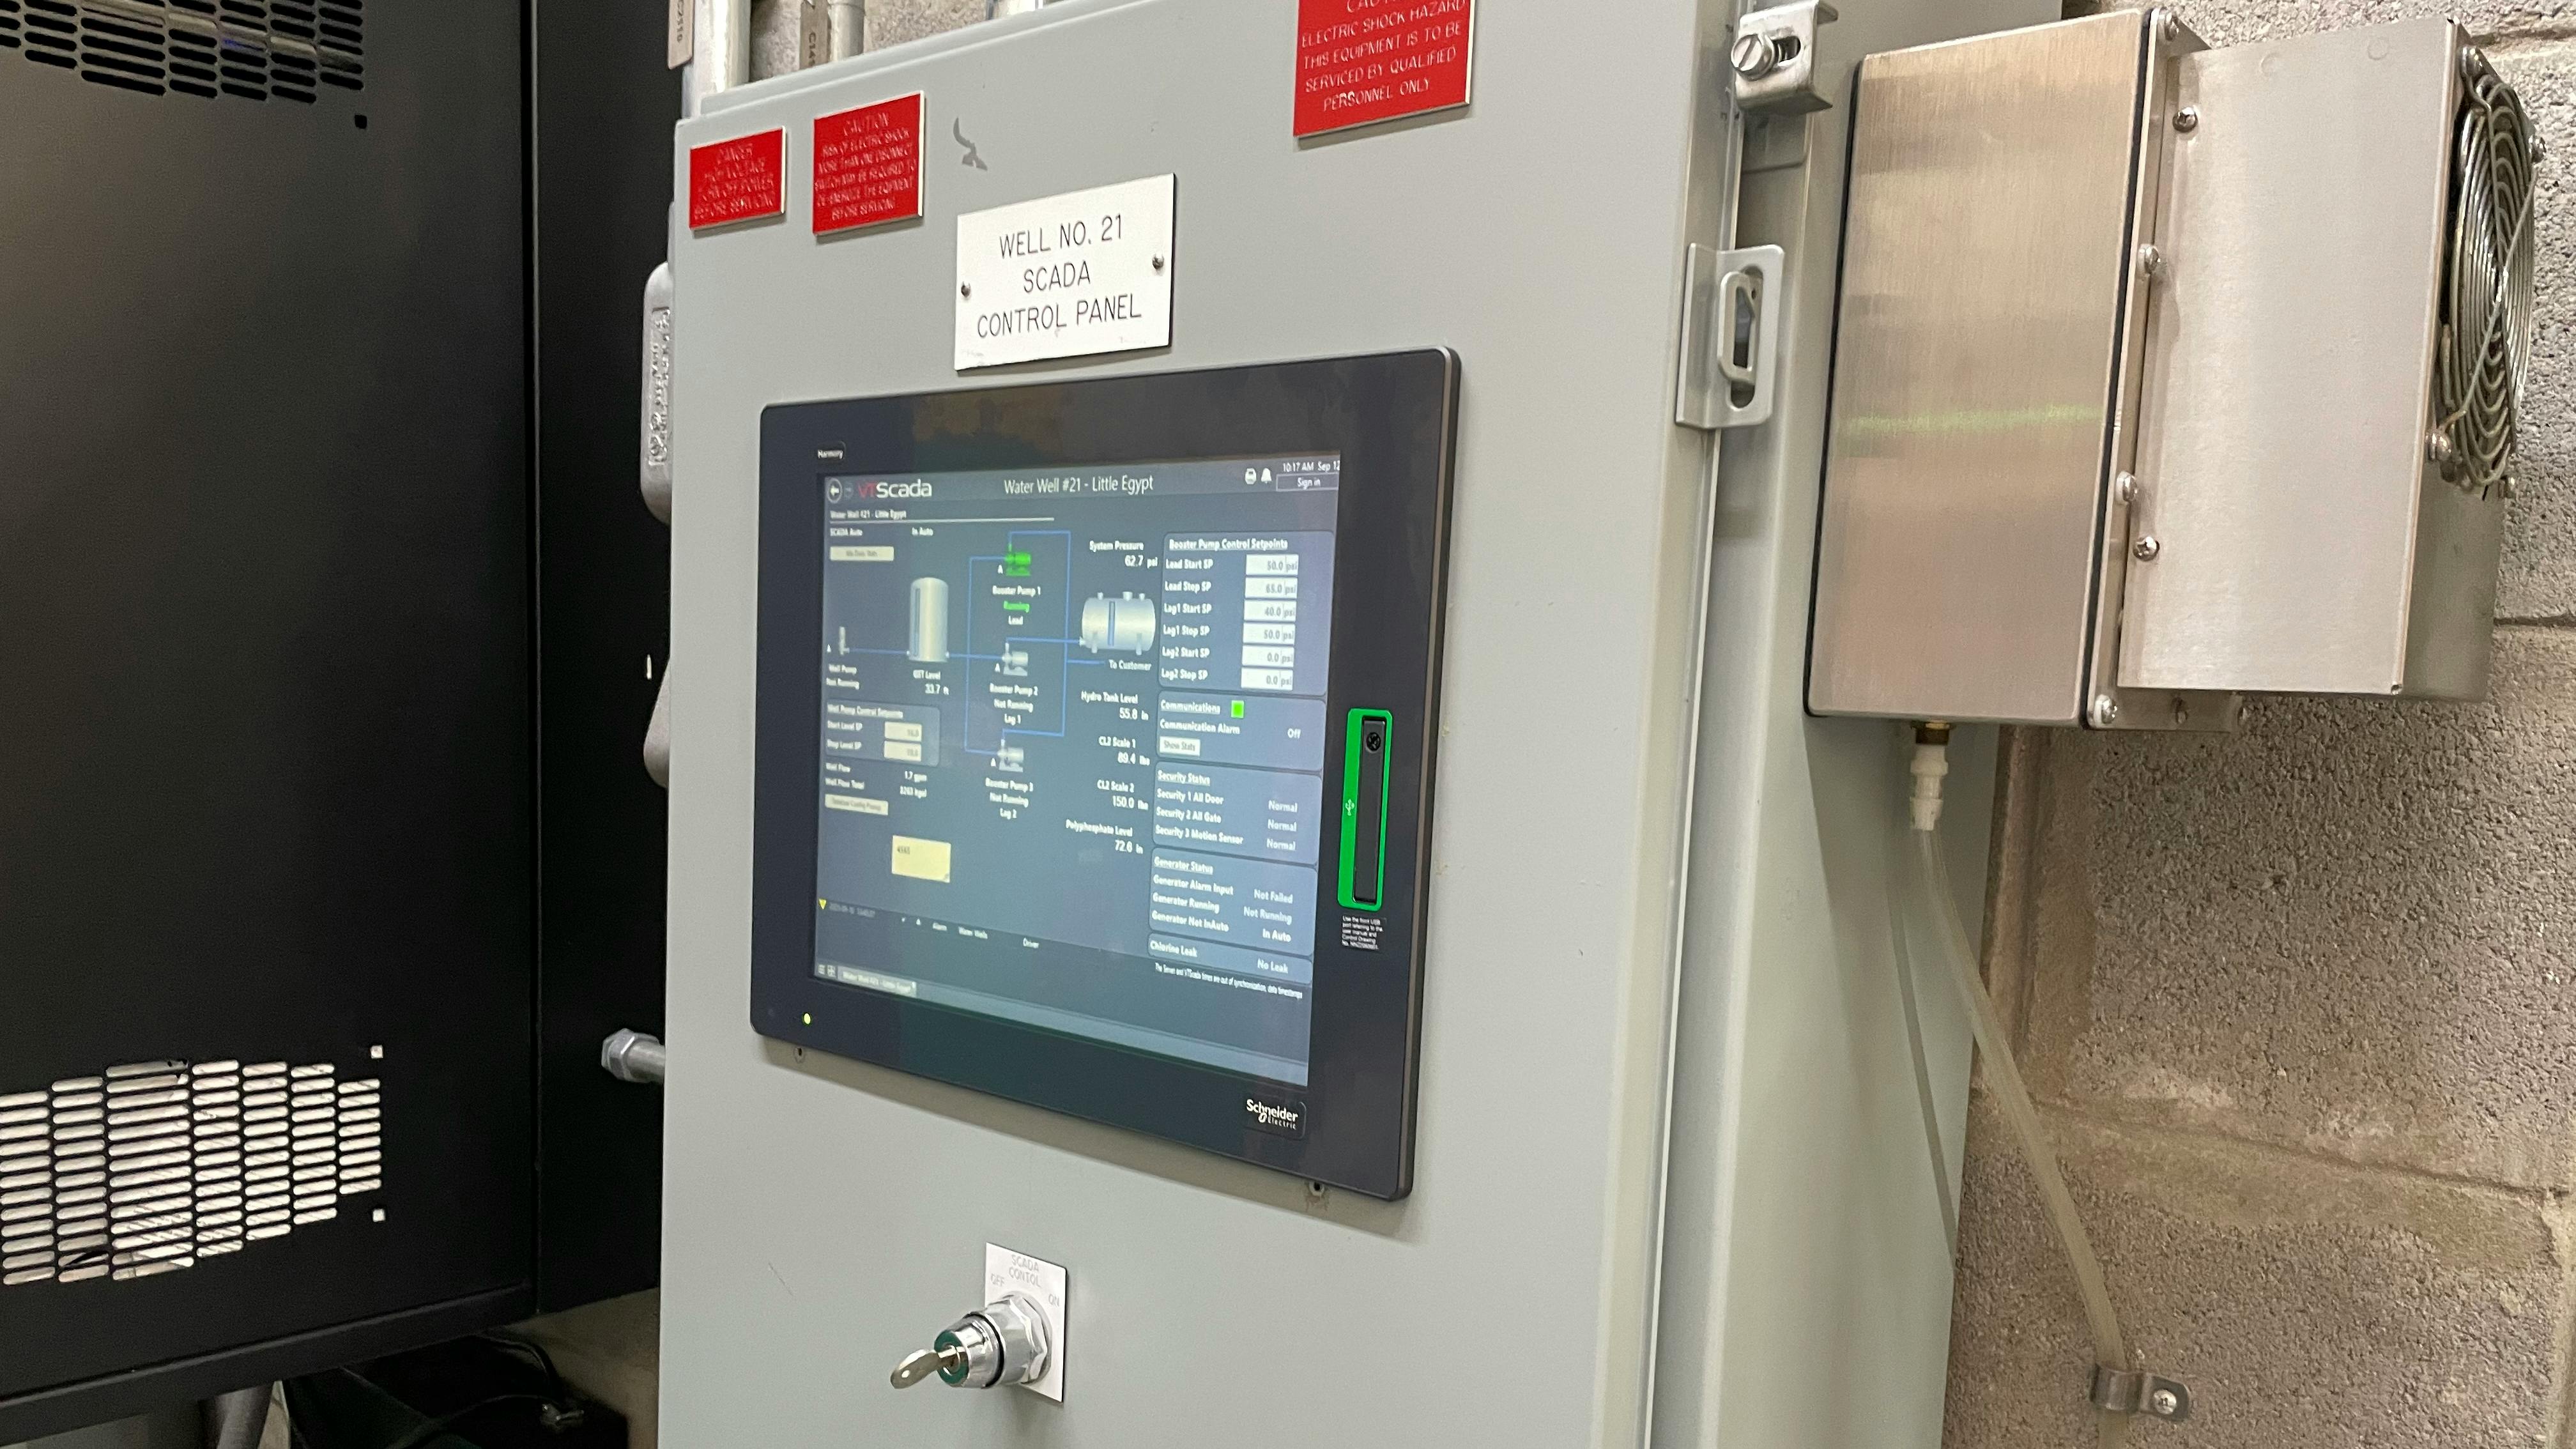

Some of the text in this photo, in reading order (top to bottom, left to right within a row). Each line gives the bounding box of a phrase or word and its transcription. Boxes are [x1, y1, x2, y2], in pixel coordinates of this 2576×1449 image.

[1301, 23, 1359, 48] ELECTRIC
[1363, 12, 1406, 33] SHOCK
[1410, 0, 1466, 22] HAZARD
[1304, 20, 1462, 69] THIS EQUIPMENT IS TO BE
[1305, 45, 1457, 93] SERVICED BY QUALIFIED
[1324, 77, 1430, 112] PERSONNEL ONLY
[999, 213, 1123, 259] WELL NO. 21
[1023, 259, 1091, 293] SCADA
[977, 293, 1142, 339] CONTROL PANEL
[1301, 461, 1314, 471] AM
[1317, 461, 1331, 473] Sep
[858, 479, 933, 498] VTScada
[1004, 479, 1034, 494] Water
[1037, 477, 1060, 493] Well
[1063, 477, 1081, 493] #21
[1092, 475, 1119, 492] Little
[1121, 474, 1154, 495] Egypt
[1298, 477, 1313, 490] Sign
[1089, 540, 1144, 552] System Pressure
[1169, 538, 1288, 551] Booster Pump Control Setpoints
[1124, 555, 1158, 568] 62.7 psi
[1165, 559, 1213, 569] Lead Start SP
[1267, 561, 1298, 573] 50.0 psi
[1165, 581, 1211, 594] Lead Stop SP
[1285, 584, 1296, 596] psi
[1164, 603, 1212, 615] Lag1 Start SP
[1264, 605, 1295, 618] 40.0 psi
[1163, 624, 1210, 638] Lag1 Stop SP
[1264, 630, 1294, 641] 50.0 psi
[1162, 647, 1210, 659] Lag2 Start SP
[1267, 653, 1293, 664] 0.0 psi
[1109, 659, 1151, 671] To Customer
[1162, 668, 1208, 681] Lag2 Stop SP
[1266, 676, 1292, 688] 0.0 psi
[1081, 691, 1138, 704] Hydro Tank Level
[1119, 707, 1137, 720] 55.8
[1161, 700, 1220, 714] Communications
[1160, 719, 1240, 734] Communication Alarm
[1287, 728, 1301, 739] Off
[1113, 737, 1130, 748] Scale
[1164, 740, 1195, 751] Show Stats
[1158, 770, 1210, 785] Security Status
[1111, 781, 1128, 792] Scale
[1130, 783, 1134, 793] 2
[1113, 795, 1135, 808] 150.0
[1157, 788, 1186, 802] Security
[1193, 792, 1204, 802] All
[1205, 793, 1223, 804] Door
[1268, 800, 1298, 813] Normal
[1156, 806, 1222, 823] Security 2 All Gate
[1115, 825, 1133, 837] Level
[1268, 819, 1296, 832] Normal
[1156, 824, 1243, 845] Security 3 Motion Sensor
[1267, 838, 1296, 851] Normal
[1154, 856, 1213, 874] Generator Status
[1153, 874, 1234, 896] Generator Alarm Input
[1153, 893, 1220, 914] Generator Running
[1254, 889, 1293, 904] Not Failed
[1152, 910, 1229, 931] Generator Not InAuto
[1244, 907, 1292, 925] Not Running
[1262, 928, 1291, 942] In Auto
[1150, 940, 1197, 957] Chlorine Leak
[1257, 958, 1288, 974] No Leak
[1246, 1099, 1298, 1122] Schneider
[1011, 1254, 1039, 1273] SCADA
[1009, 1267, 1043, 1288] CONTOL
[990, 1273, 1060, 1307] OFF ON
